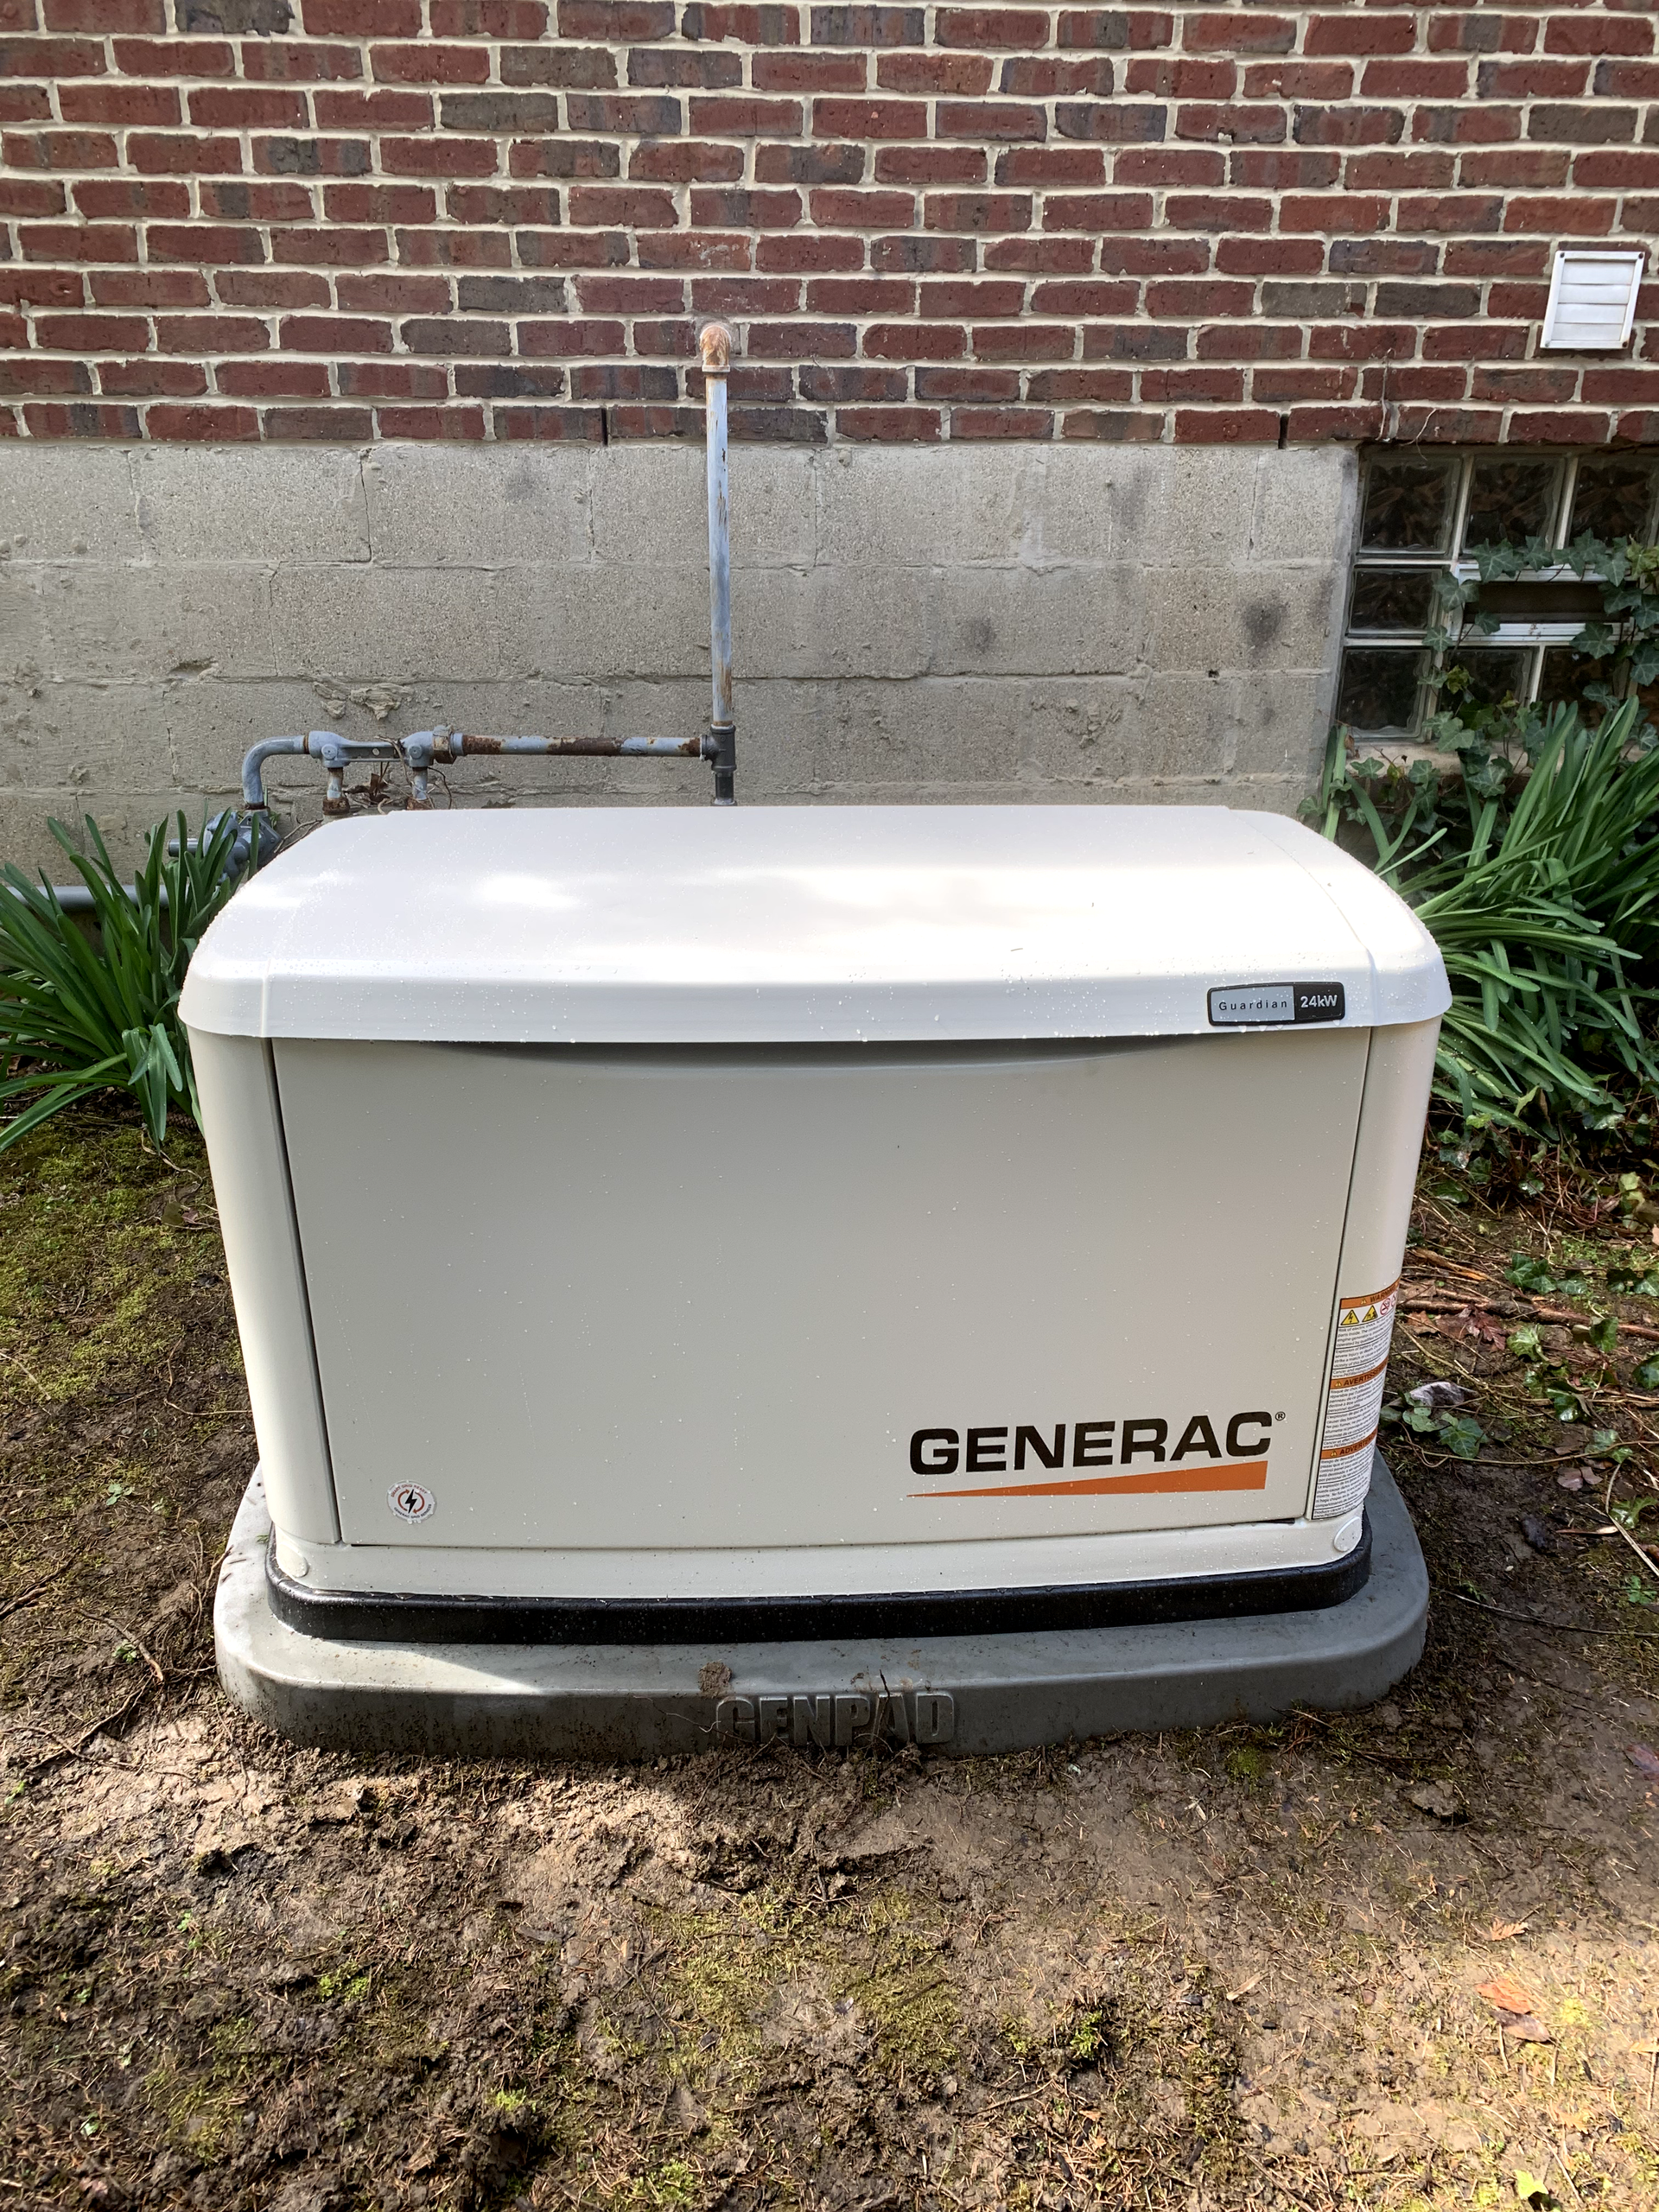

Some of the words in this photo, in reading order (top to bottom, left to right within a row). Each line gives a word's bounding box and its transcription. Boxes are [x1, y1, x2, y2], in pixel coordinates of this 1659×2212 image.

[1218, 1000, 1287, 1010] Guardian
[1300, 995, 1338, 1008] 24kW
[413, 1484, 428, 1494] READY
[716, 1692, 955, 1745] GENPAD
